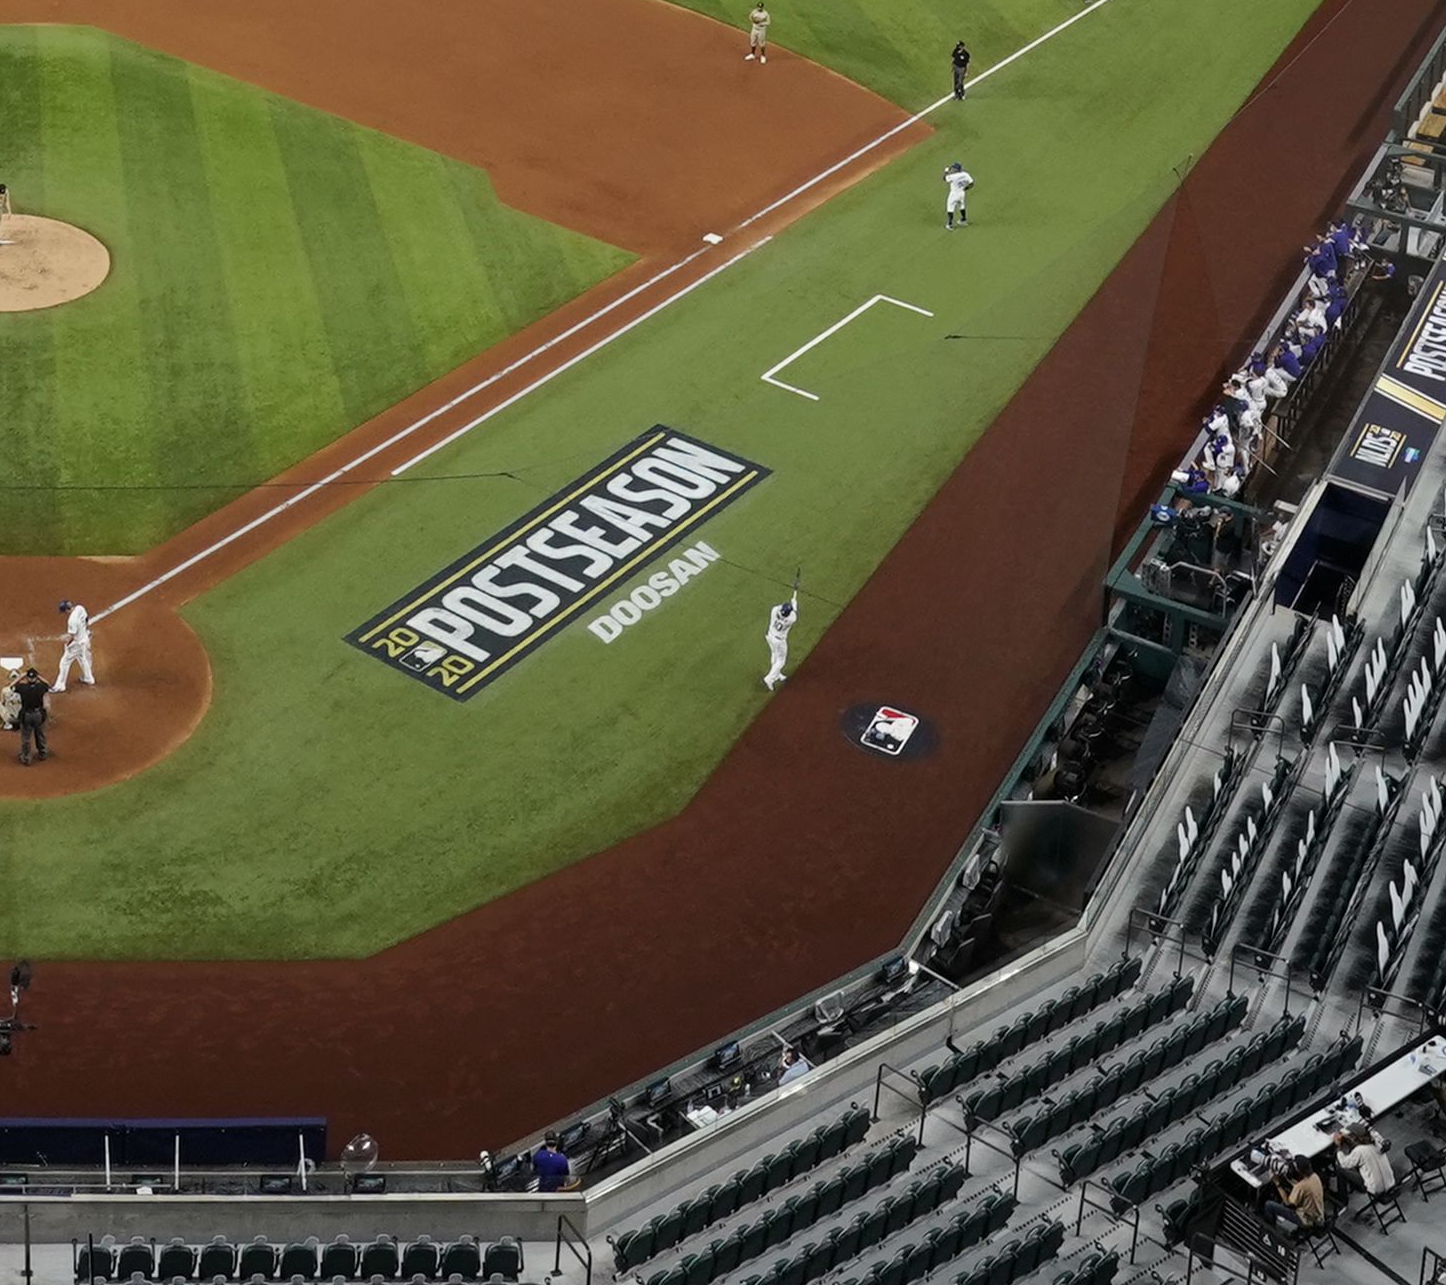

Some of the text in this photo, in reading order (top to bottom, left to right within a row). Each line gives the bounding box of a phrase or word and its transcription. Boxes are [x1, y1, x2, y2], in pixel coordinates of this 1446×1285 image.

[406, 436, 746, 663] POSTSEASON
[587, 540, 721, 645] DOOSAN
[372, 627, 421, 658] 20
[427, 654, 475, 687] 20
